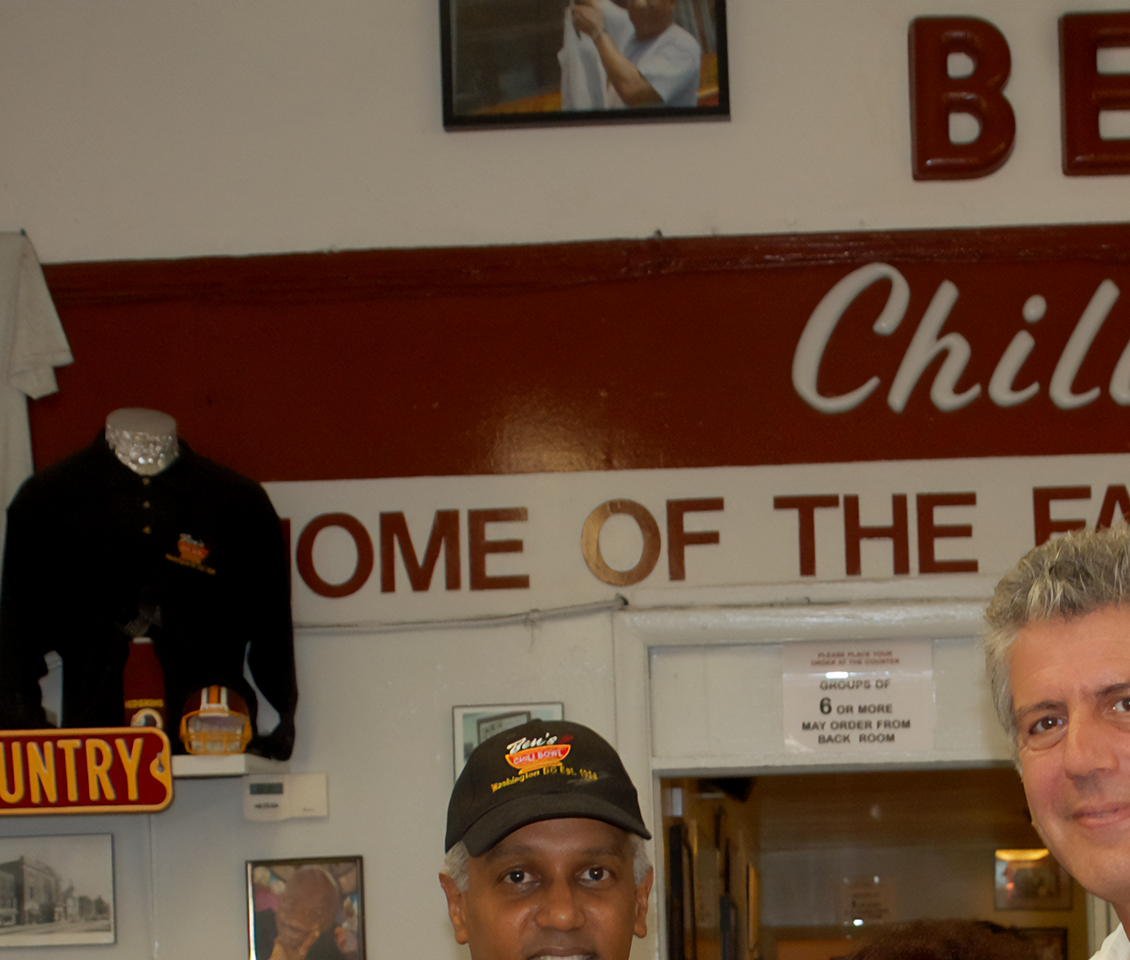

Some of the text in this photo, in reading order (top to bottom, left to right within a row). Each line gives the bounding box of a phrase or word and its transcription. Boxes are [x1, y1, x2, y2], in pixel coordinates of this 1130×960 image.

[581, 497, 725, 587] OF
[774, 492, 979, 577] THE
[819, 679, 890, 690] GROUPS OF
[819, 697, 892, 715] 6 OR MORE
[802, 720, 911, 731] MAY ORDER FROM
[506, 732, 558, 755] Ben's
[818, 733, 895, 744] BACK ROOM
